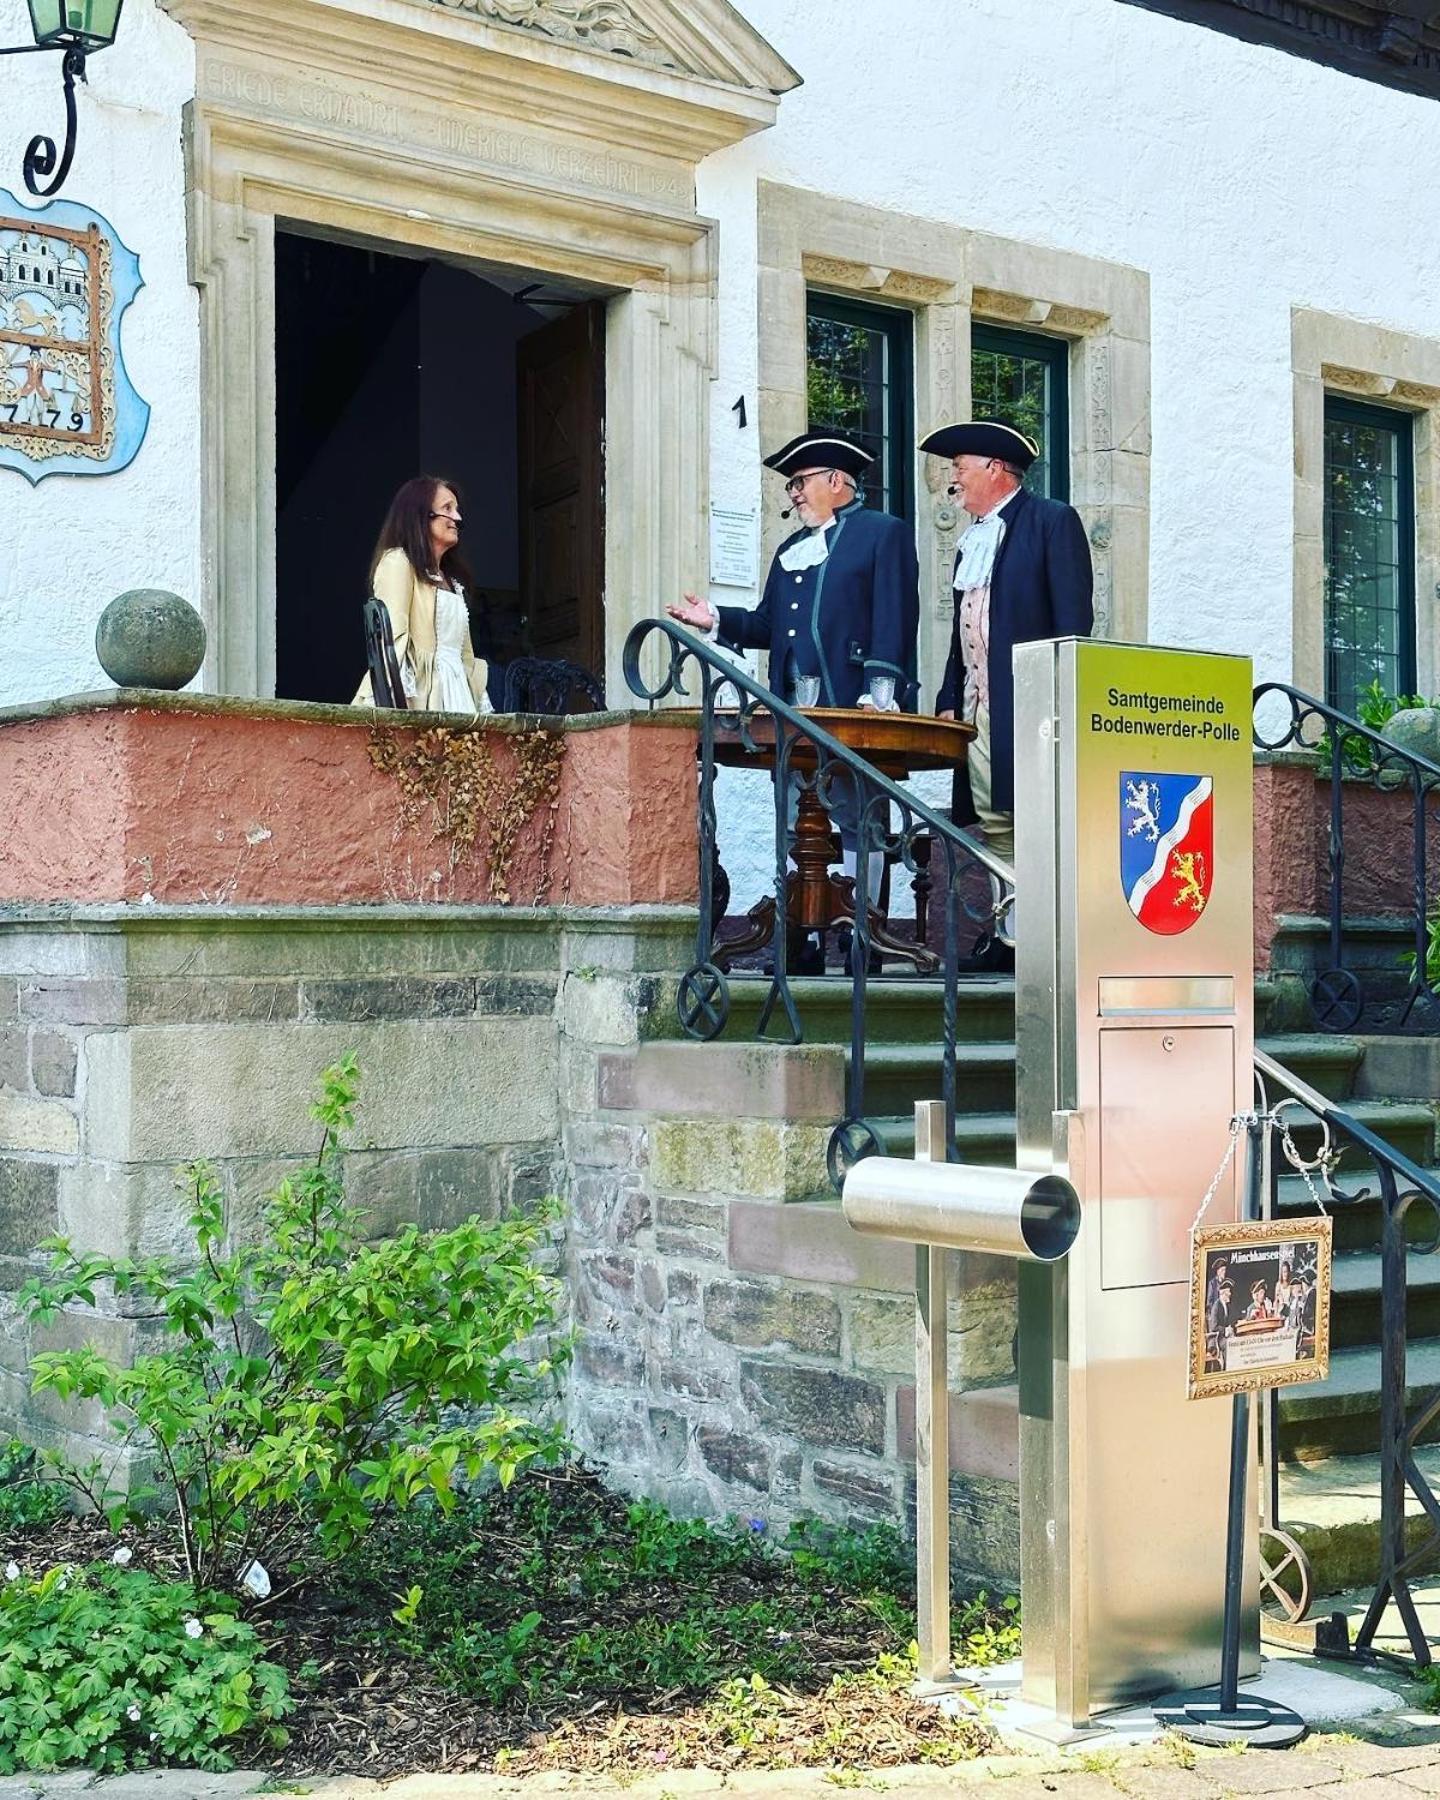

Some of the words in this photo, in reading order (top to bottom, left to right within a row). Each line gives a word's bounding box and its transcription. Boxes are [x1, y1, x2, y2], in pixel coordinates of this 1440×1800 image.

[731, 394, 747, 429] 1
[1108, 688, 1224, 714] Samtgemeinde
[1091, 713, 1240, 741] Bodenwerder-Polle
